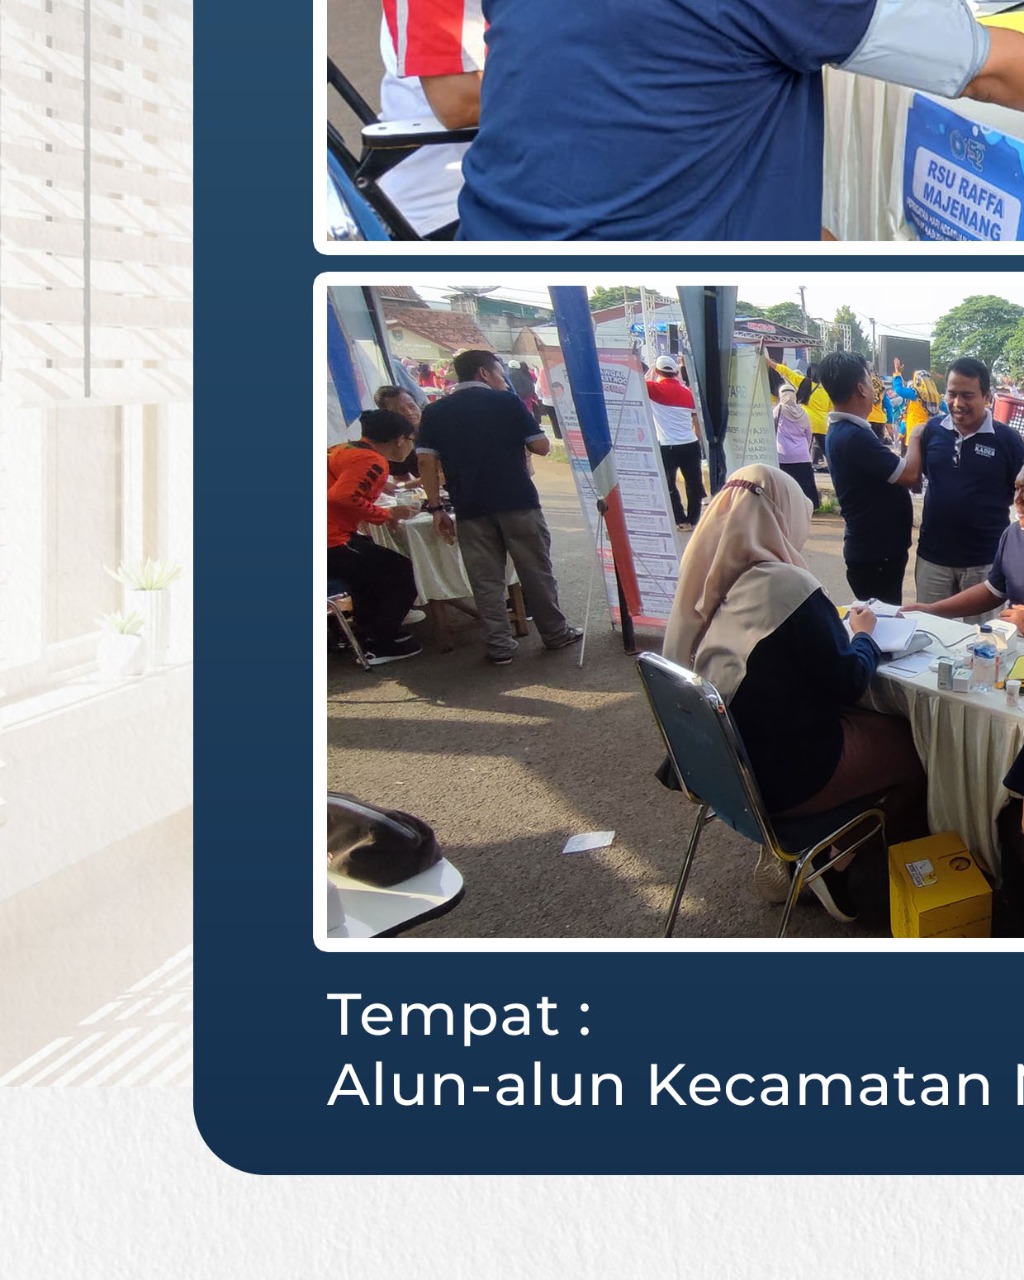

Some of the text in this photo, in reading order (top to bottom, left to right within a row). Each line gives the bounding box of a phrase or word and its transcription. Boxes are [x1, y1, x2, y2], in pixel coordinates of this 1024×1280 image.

[923, 182, 1002, 240] MAJENANG
[927, 160, 957, 189] RSU
[958, 177, 1004, 219] RAFFA
